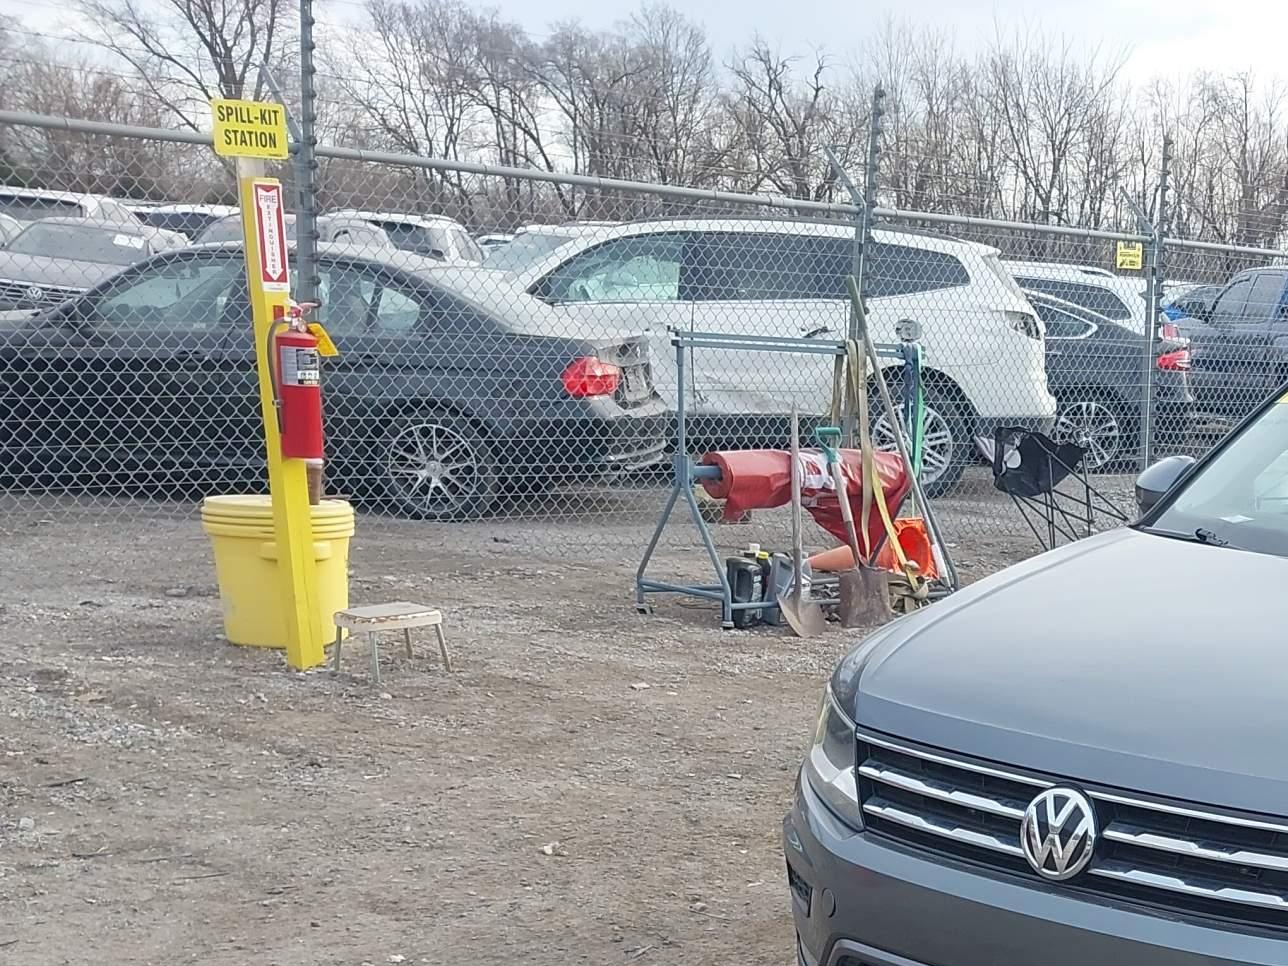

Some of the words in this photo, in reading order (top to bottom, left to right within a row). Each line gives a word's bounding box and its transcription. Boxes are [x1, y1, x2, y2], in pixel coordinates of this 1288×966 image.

[217, 105, 279, 126] SPILL-KIT
[224, 128, 277, 149] STATION
[259, 194, 277, 204] FIRE
